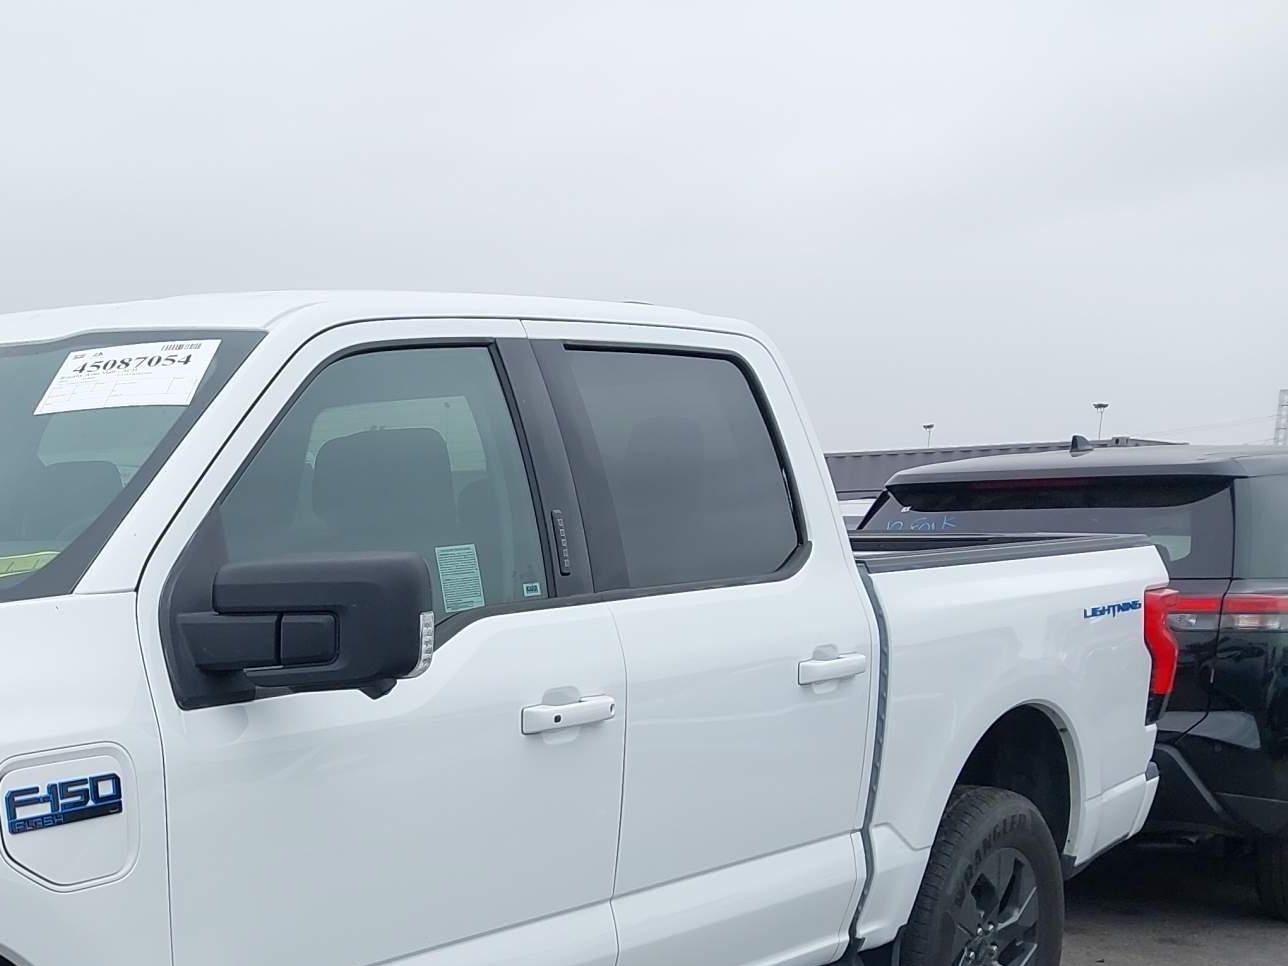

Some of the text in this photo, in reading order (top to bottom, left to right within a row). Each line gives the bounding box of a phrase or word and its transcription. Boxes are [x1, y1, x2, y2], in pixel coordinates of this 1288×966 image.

[72, 354, 192, 374] 45087054
[1083, 600, 1142, 619] LIGHTNING
[5, 773, 122, 820] F-150
